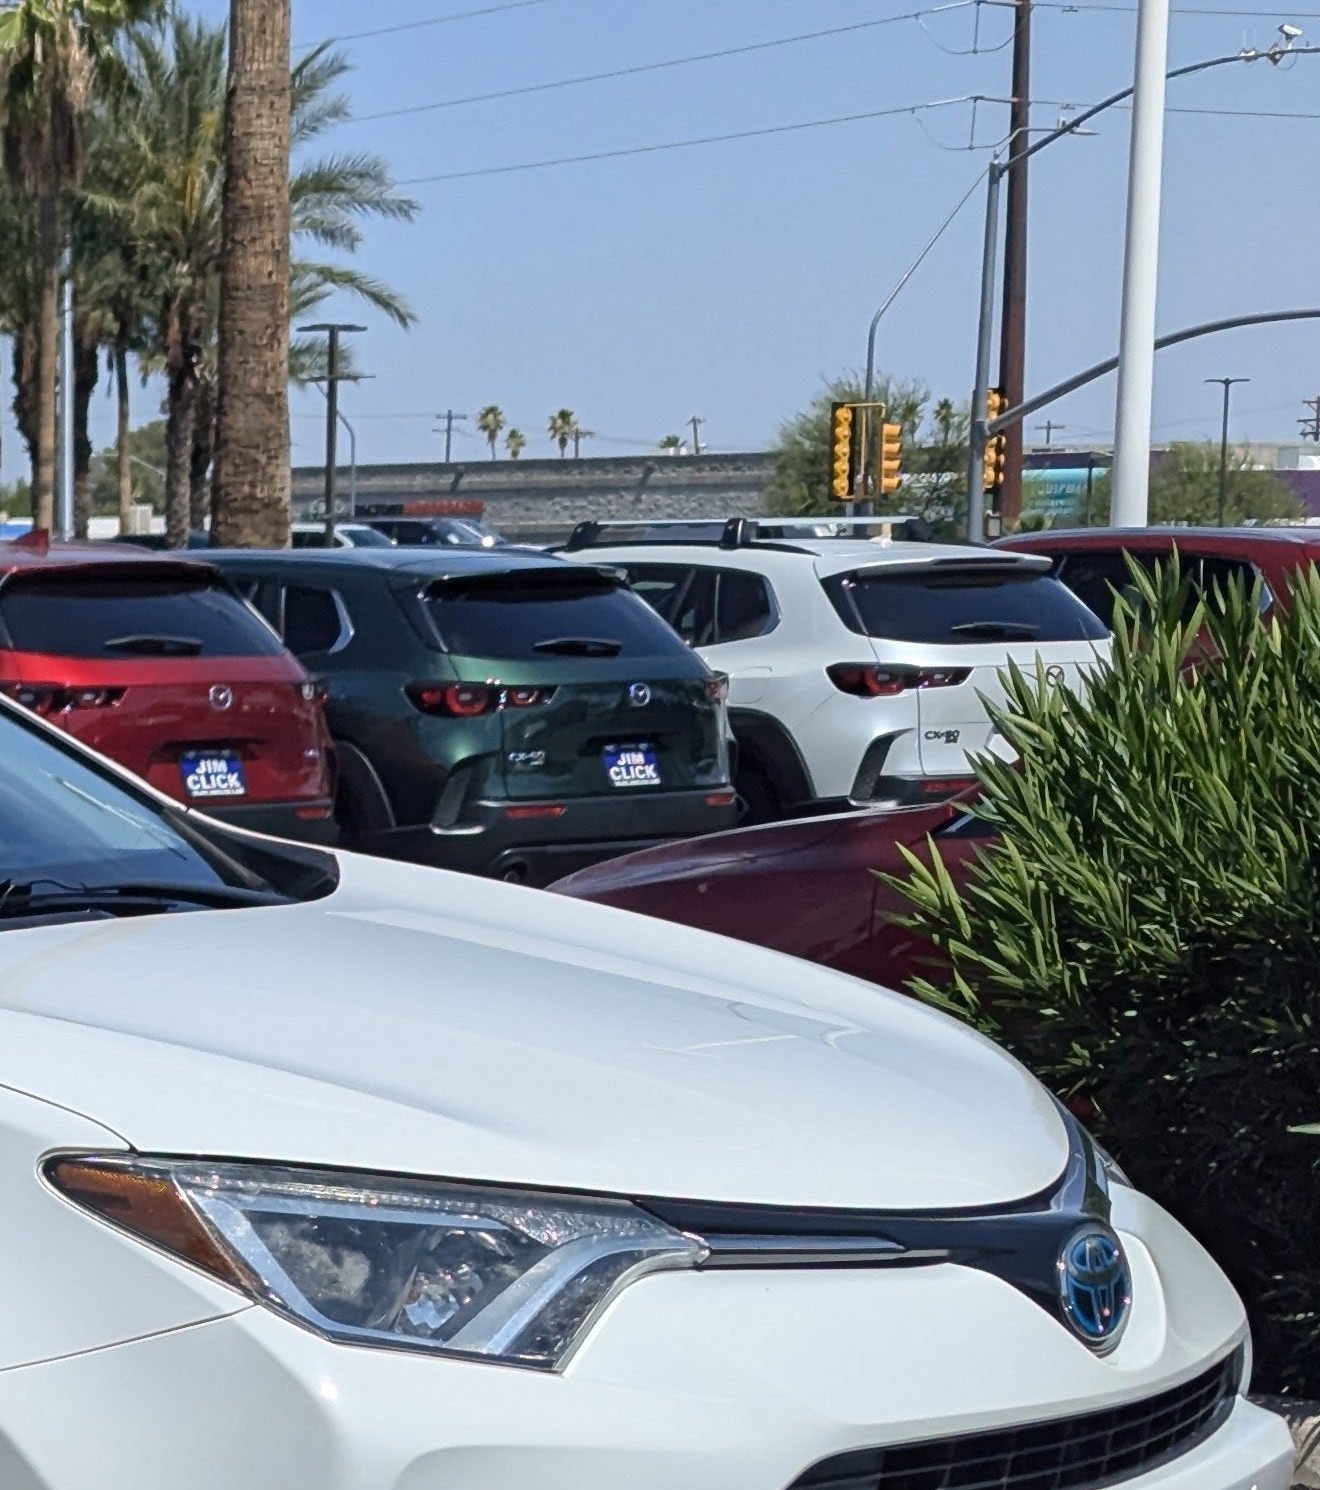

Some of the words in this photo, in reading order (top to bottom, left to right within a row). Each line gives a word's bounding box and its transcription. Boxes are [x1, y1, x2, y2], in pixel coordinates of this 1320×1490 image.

[616, 752, 645, 765] JIM
[195, 759, 229, 775] JIM
[609, 763, 657, 780] CLICK
[186, 772, 242, 790] CLICK
